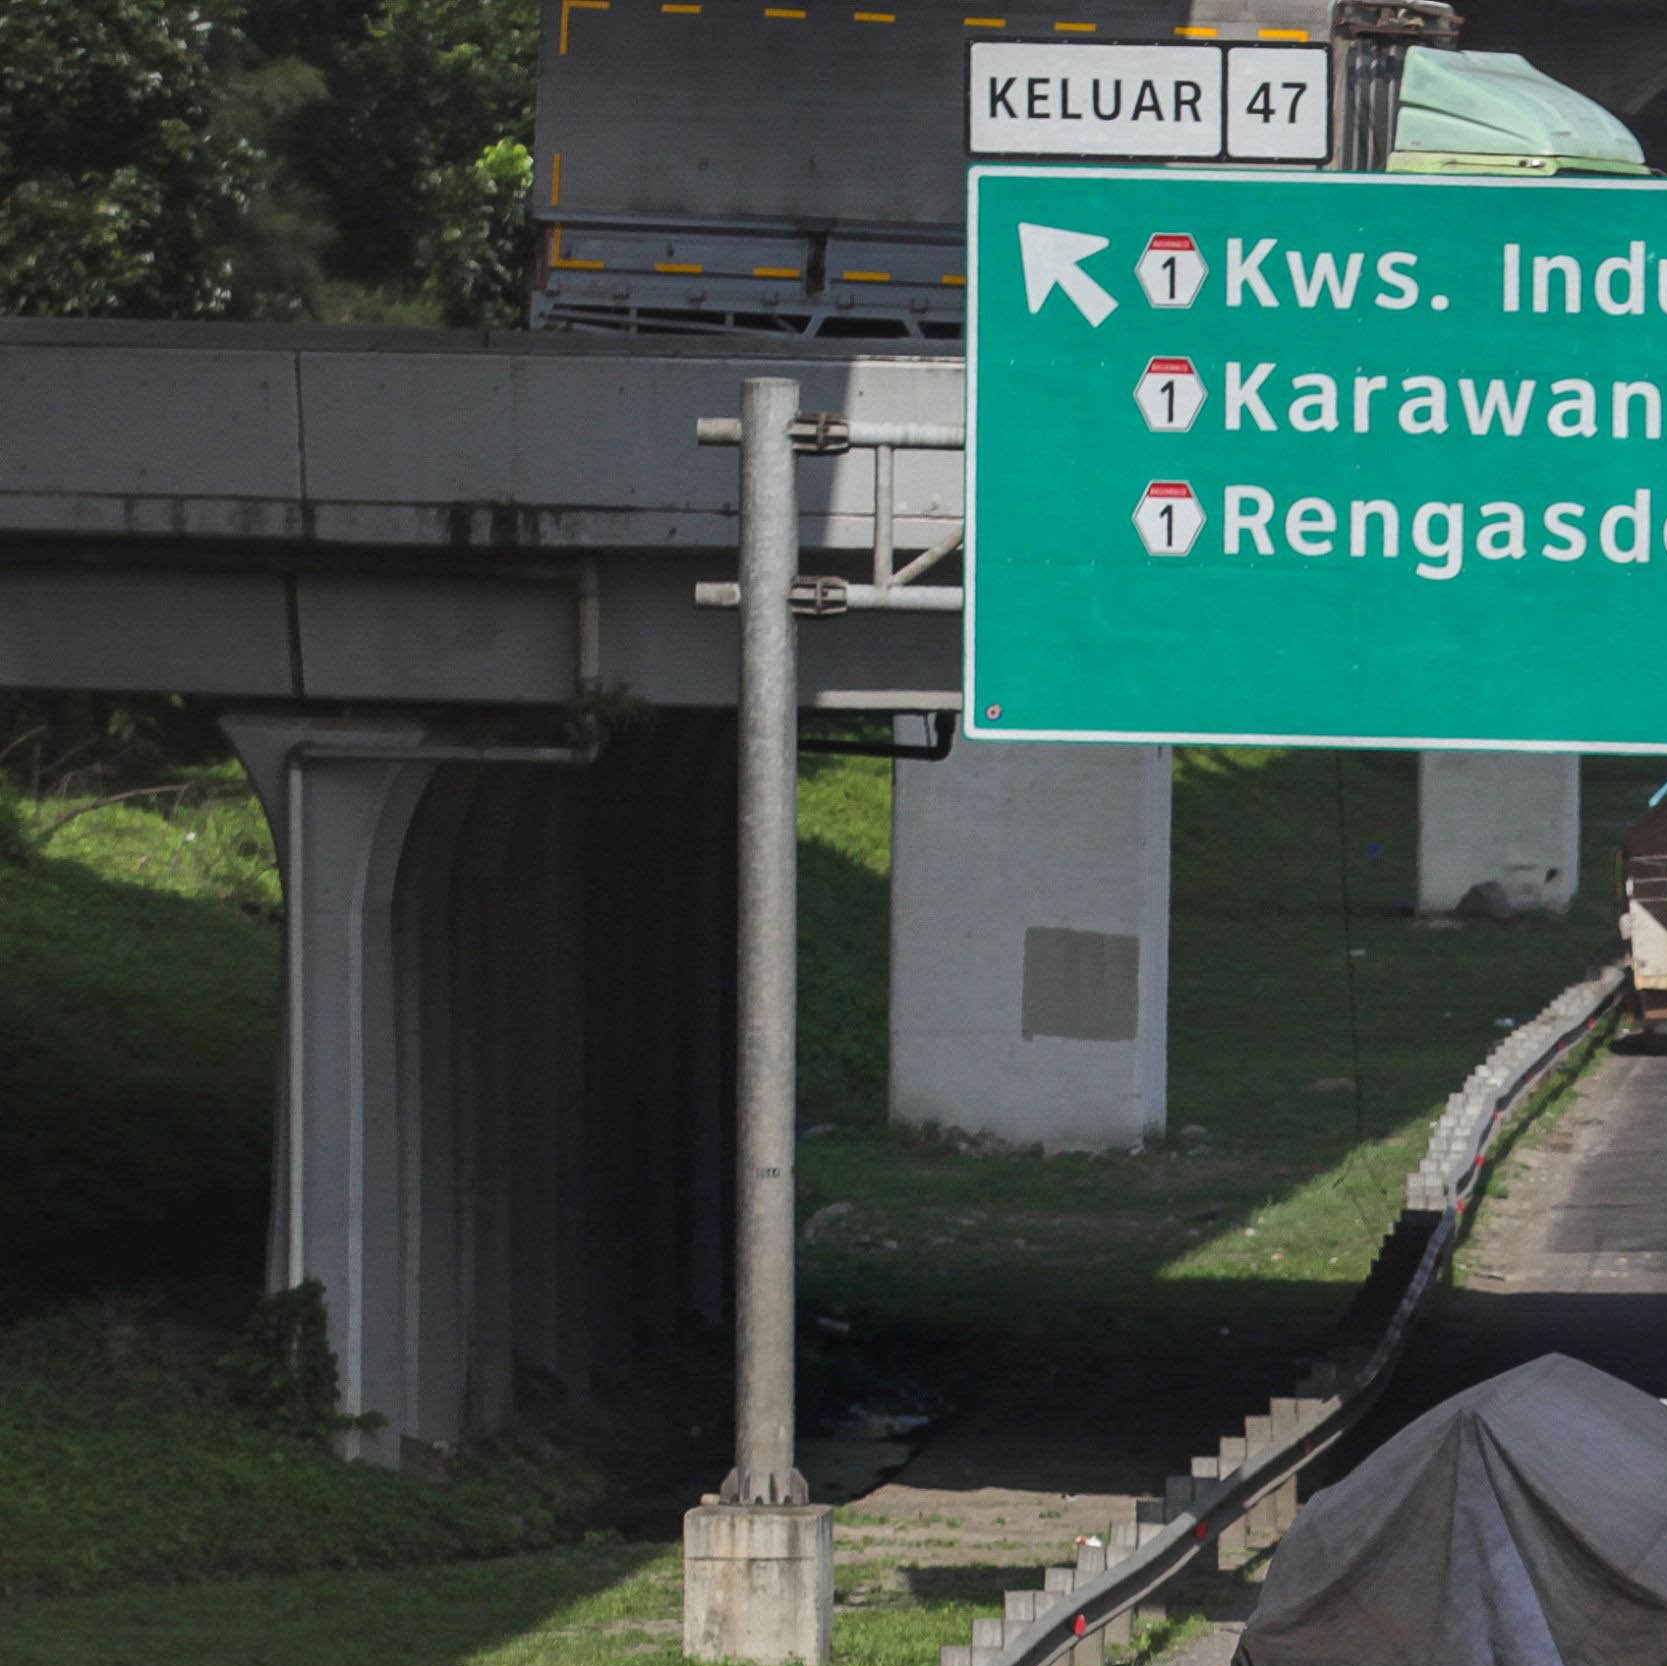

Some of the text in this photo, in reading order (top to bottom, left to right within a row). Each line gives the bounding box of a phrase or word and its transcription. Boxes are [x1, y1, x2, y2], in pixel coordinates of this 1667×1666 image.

[988, 76, 1203, 123] KELUAR
[1246, 81, 1308, 125] 47
[1161, 256, 1176, 300] 1
[1224, 238, 1450, 311] Kws.
[1160, 380, 1175, 424] 1
[1159, 503, 1174, 548] 1
